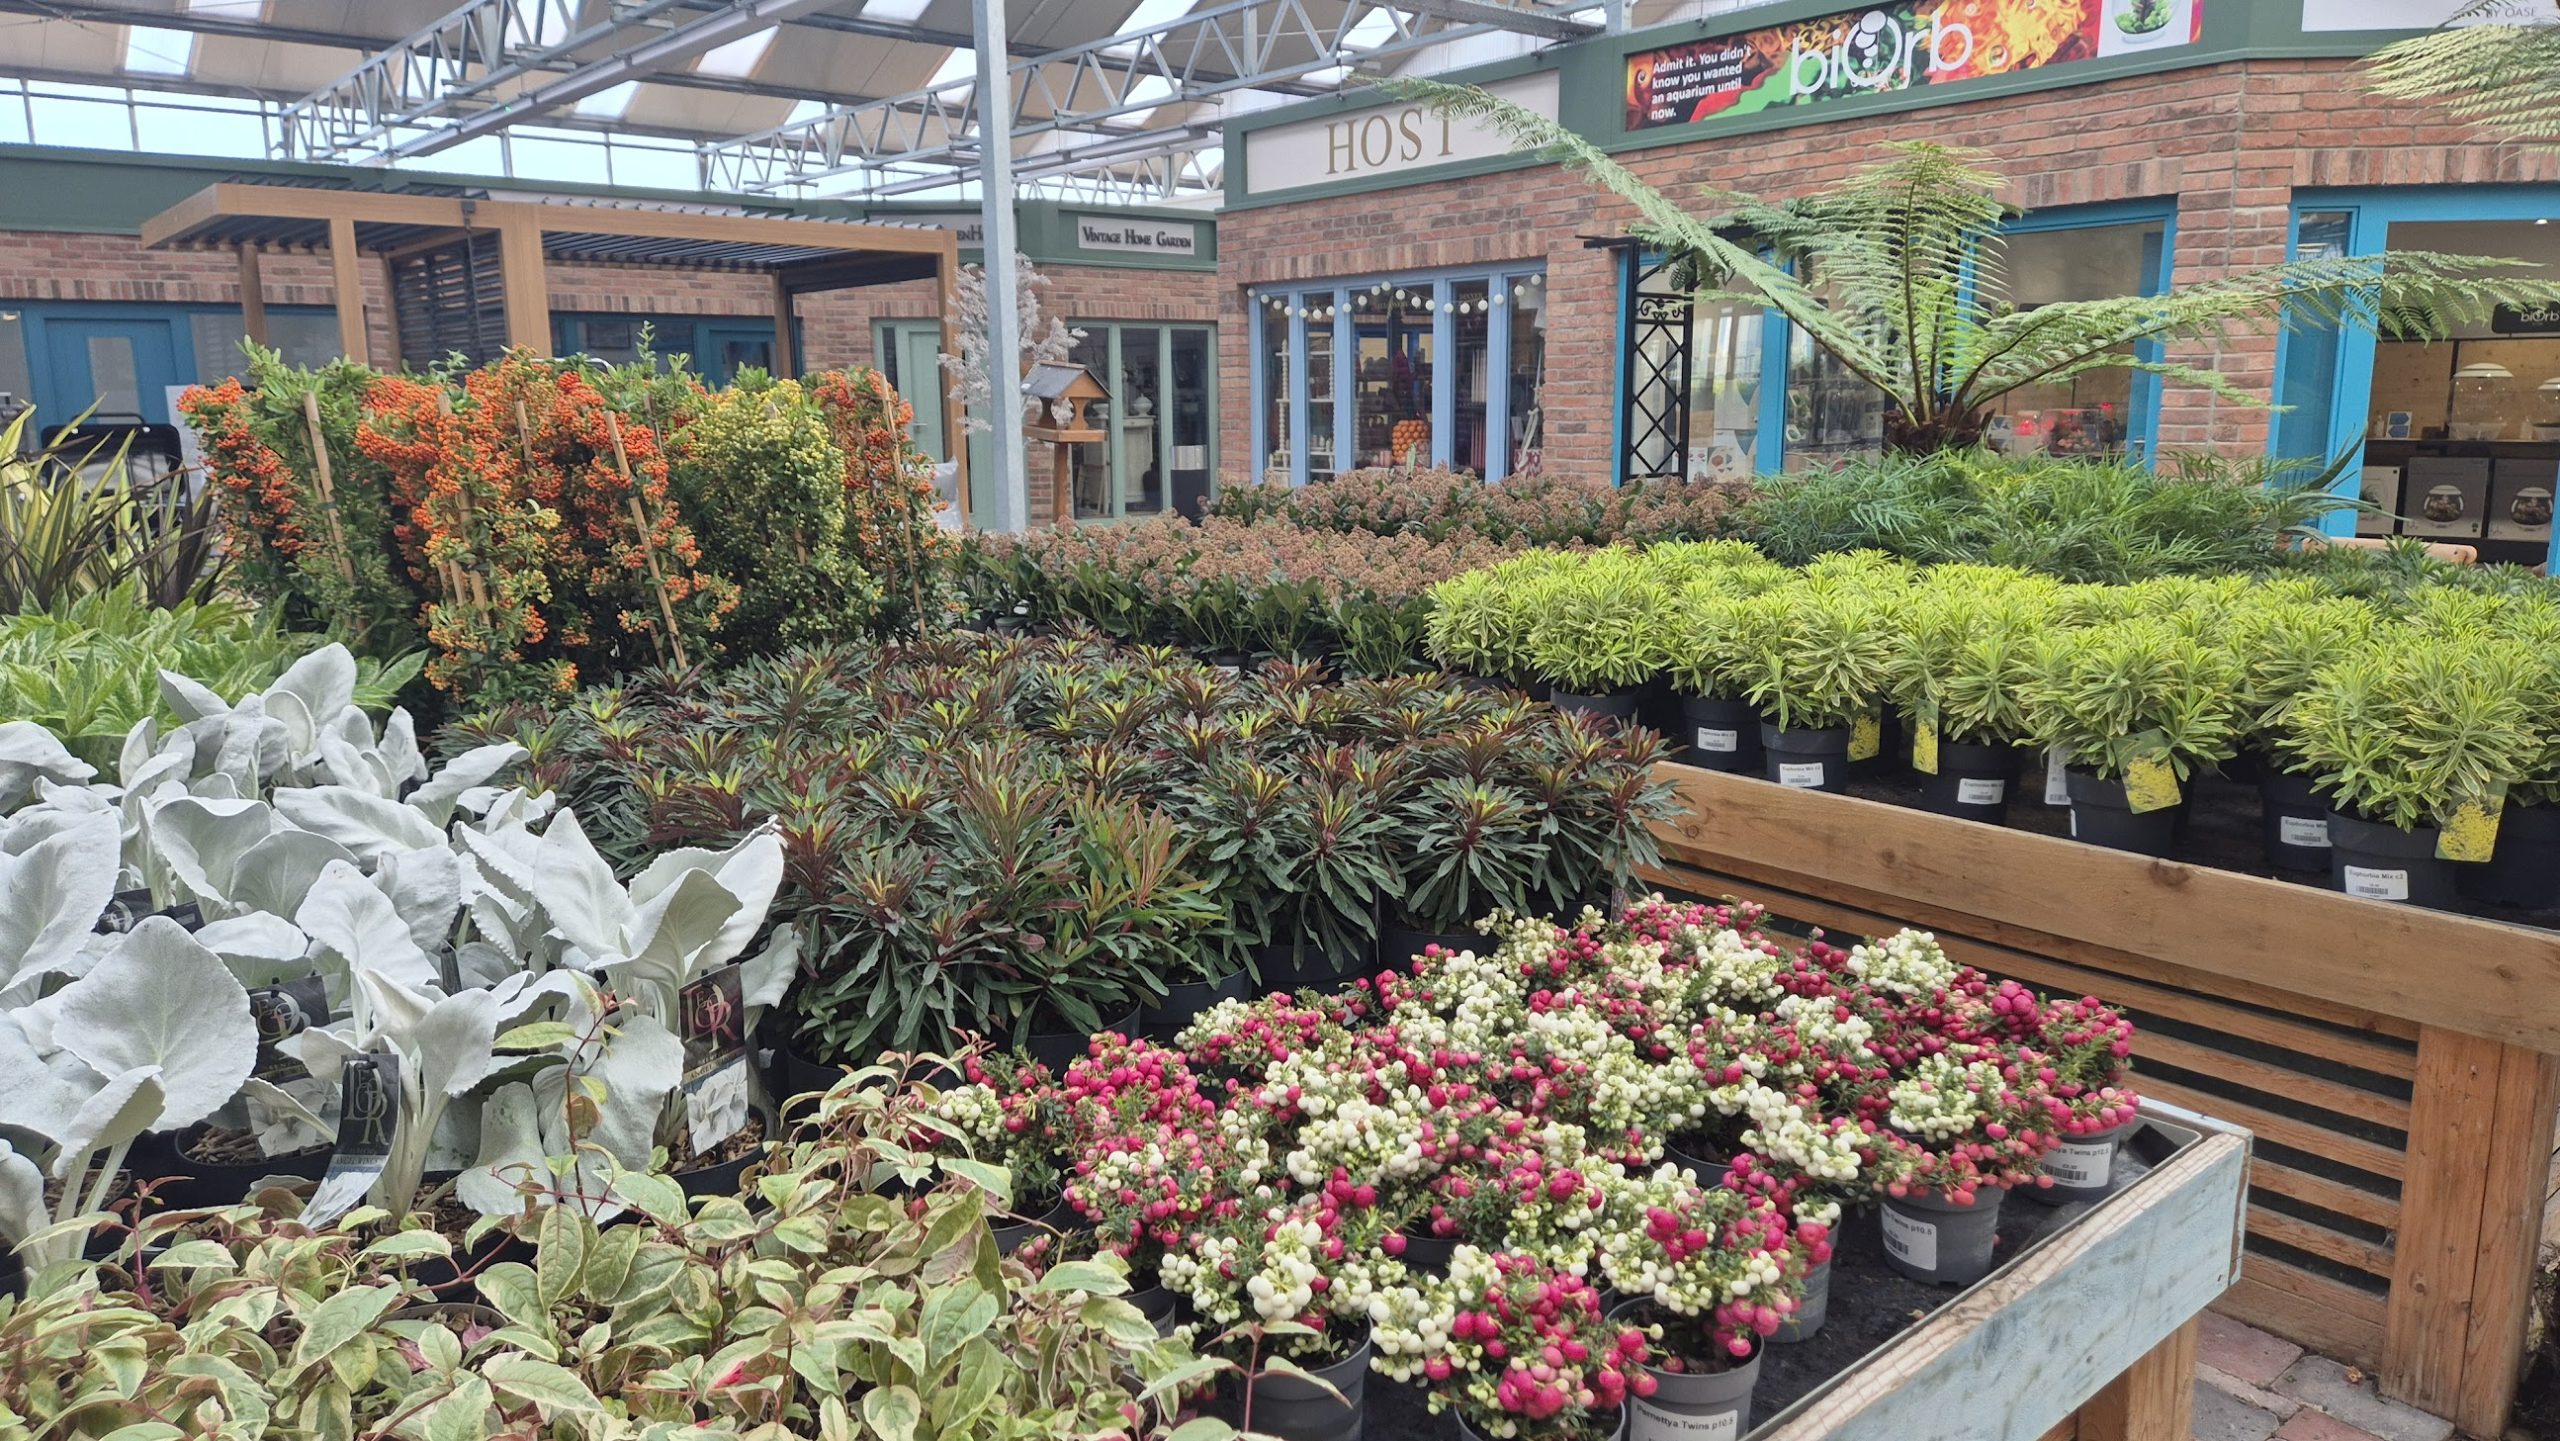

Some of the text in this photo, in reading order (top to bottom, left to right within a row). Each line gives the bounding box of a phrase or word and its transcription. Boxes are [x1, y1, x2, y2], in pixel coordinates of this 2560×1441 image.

[1653, 44, 1752, 74] Admit it. You didn't
[1652, 61, 1743, 90] know you wanted
[1651, 76, 1742, 105] an aquarium until
[1651, 107, 1677, 120] now.
[1325, 102, 1457, 175] HOST
[1636, 1403, 1679, 1428] Pernettya
[1682, 1419, 1710, 1431] Twins
